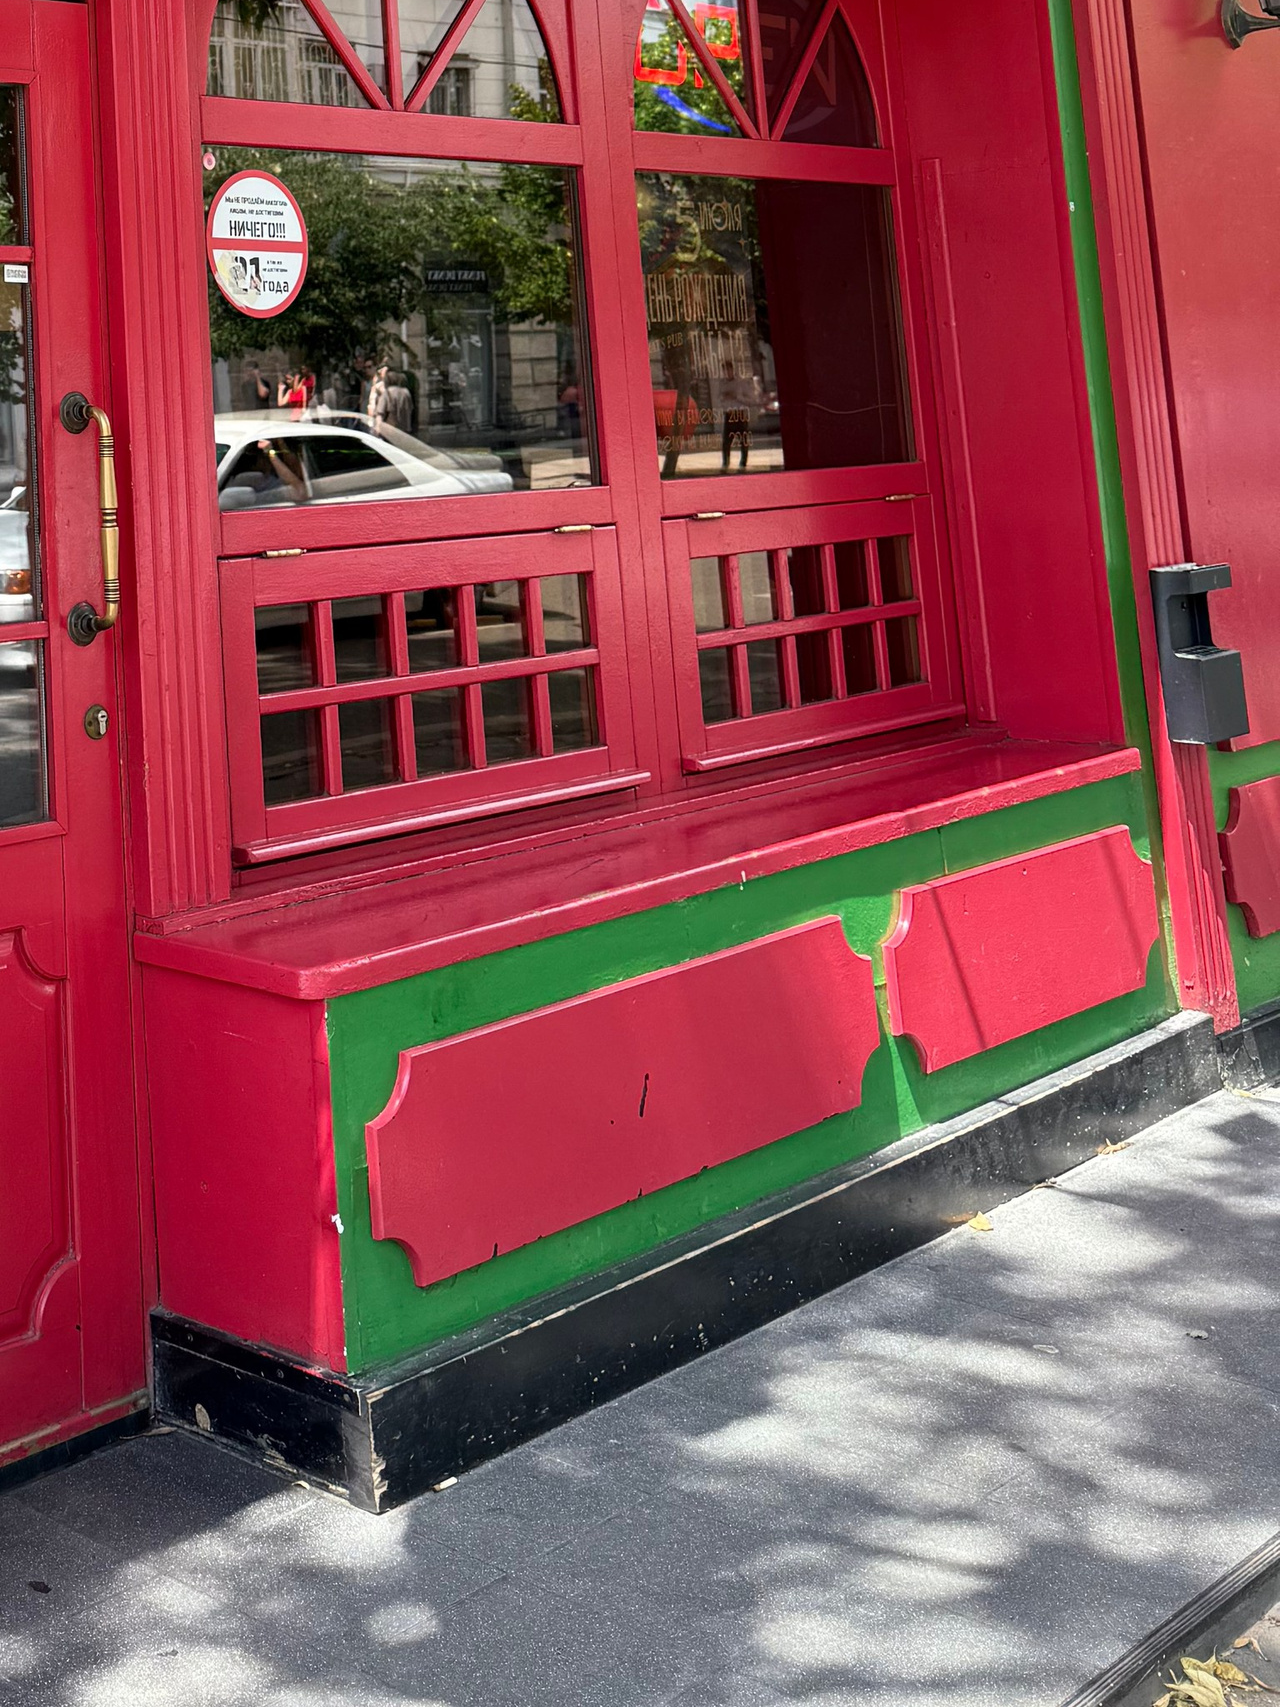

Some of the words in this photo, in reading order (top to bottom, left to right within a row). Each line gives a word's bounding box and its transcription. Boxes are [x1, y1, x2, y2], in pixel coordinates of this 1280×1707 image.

[229, 220, 286, 238] НИЧЕГО!!!
[675, 200, 701, 262] 5
[698, 202, 742, 232] ИЮЛЯ
[262, 280, 289, 294] года
[646, 274, 671, 326] ЕНЬ
[673, 274, 750, 329] РОЖДЕНИЯ
[667, 331, 684, 349] PUB
